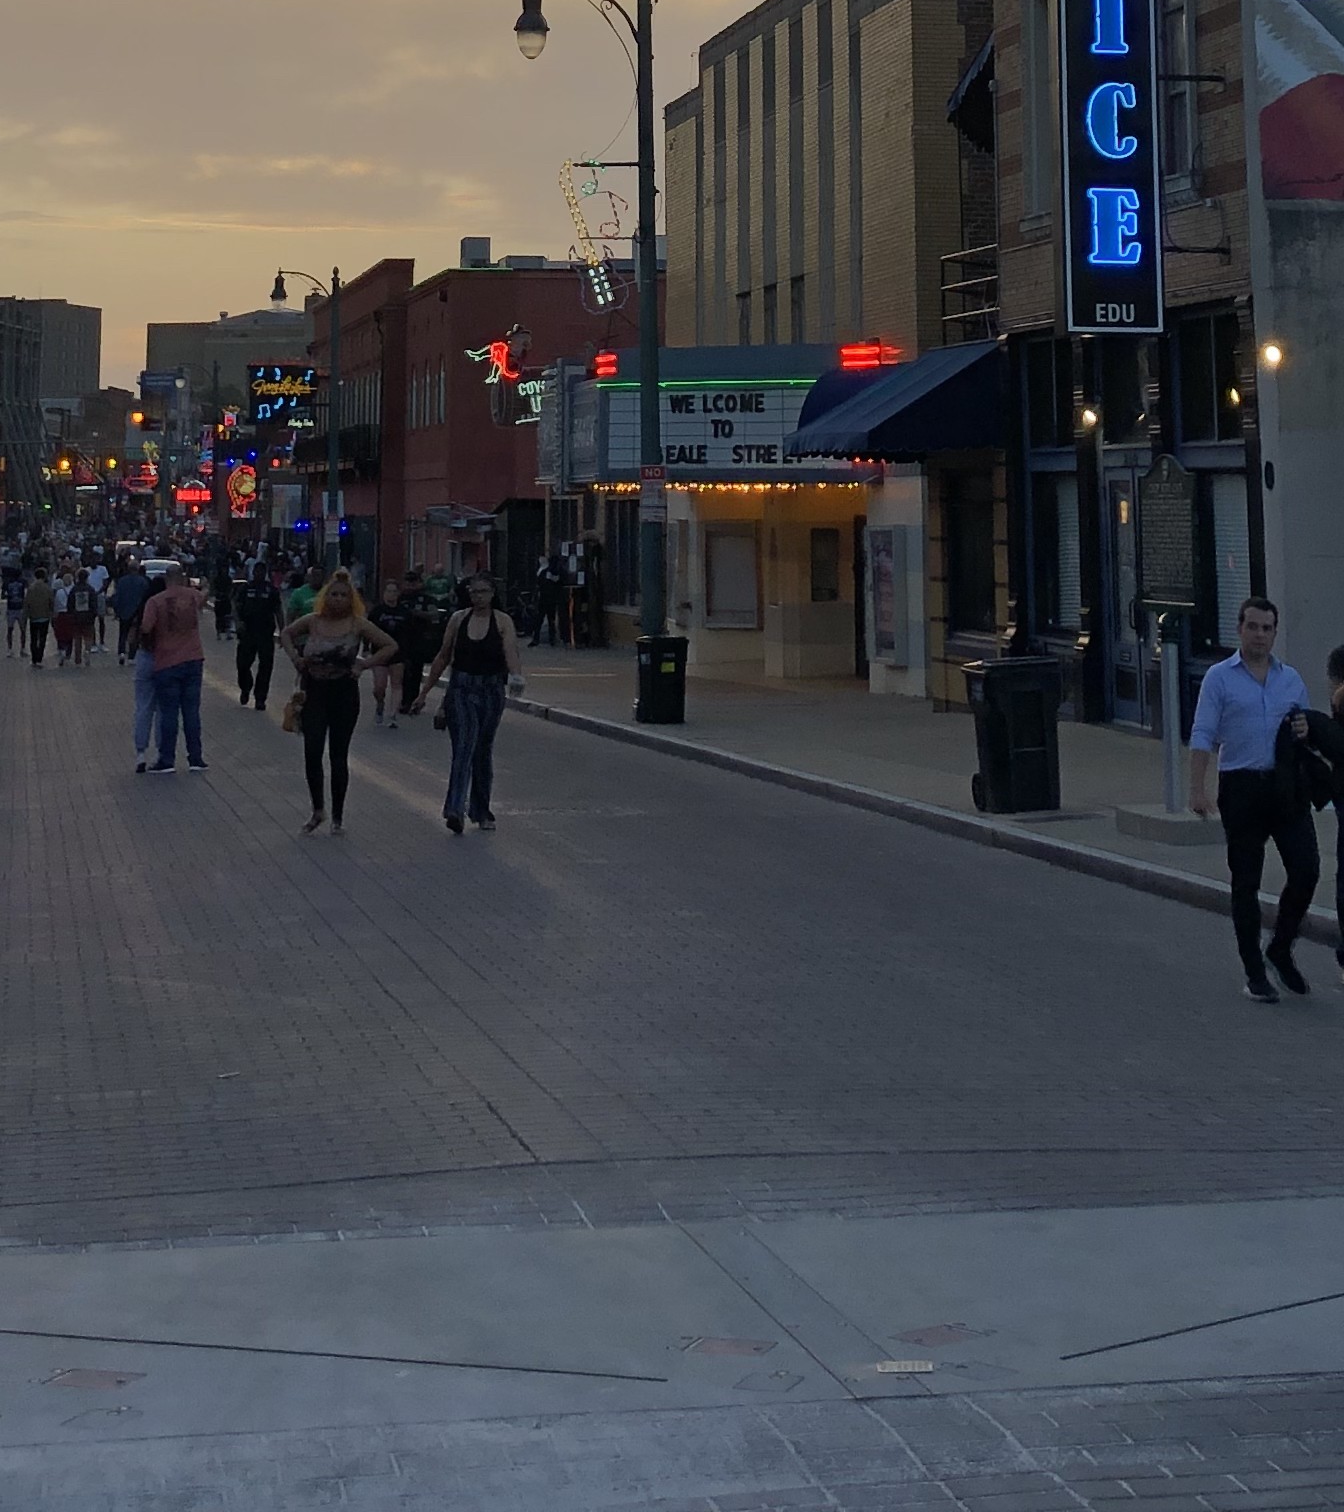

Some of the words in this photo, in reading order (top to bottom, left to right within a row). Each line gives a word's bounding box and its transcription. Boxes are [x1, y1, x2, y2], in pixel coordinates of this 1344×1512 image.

[1095, 303, 1136, 324] EDU
[518, 381, 545, 397] COY
[711, 419, 734, 438] TO
[645, 467, 662, 477] NO
